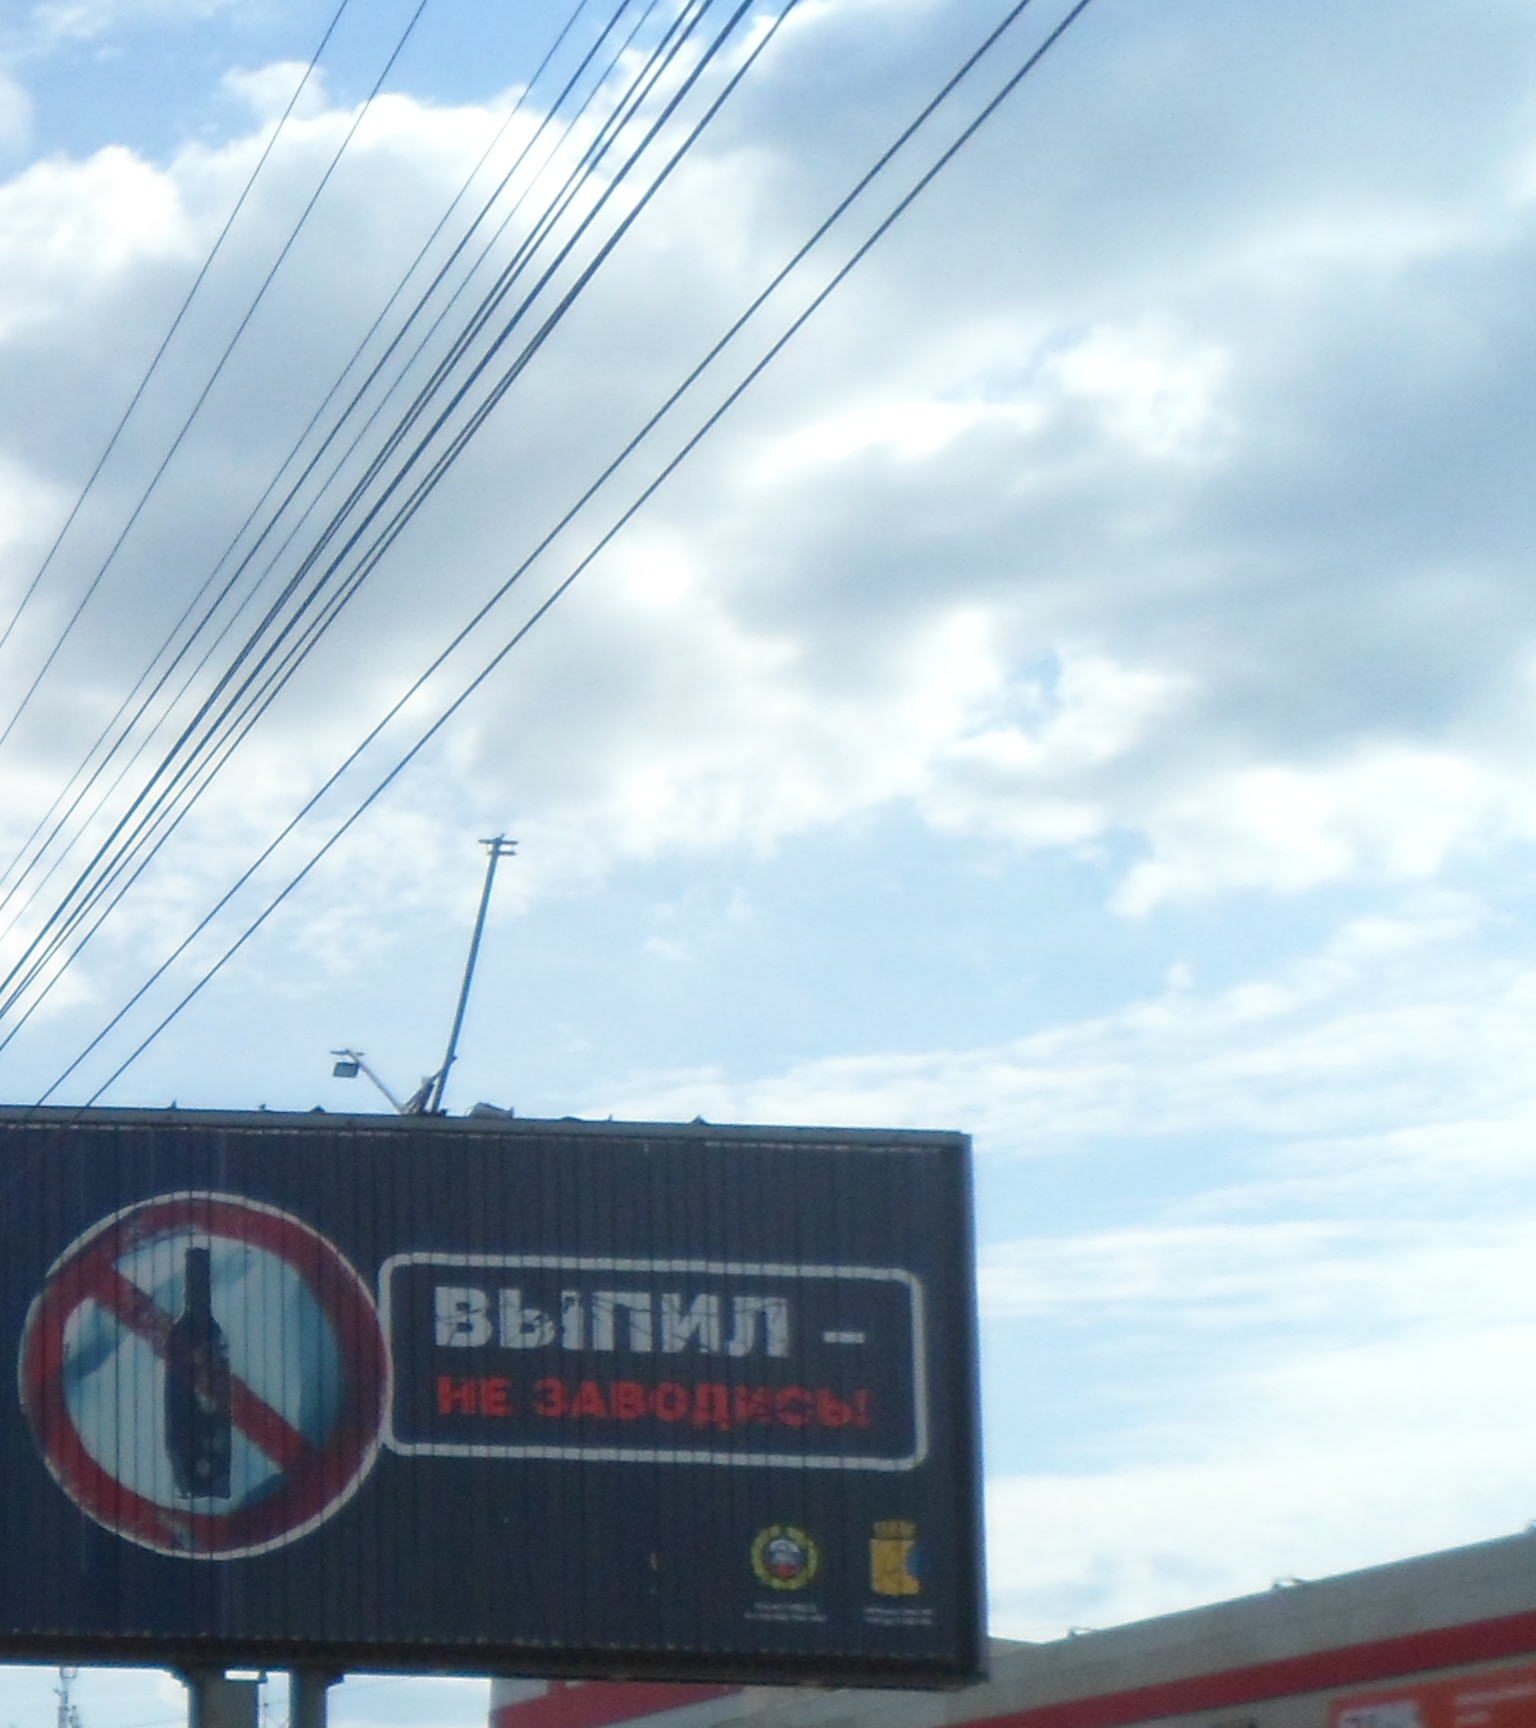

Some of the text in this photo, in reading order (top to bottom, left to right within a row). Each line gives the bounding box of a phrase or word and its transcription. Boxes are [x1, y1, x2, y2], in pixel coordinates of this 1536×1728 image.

[434, 1286, 790, 1357] ВЫПИЛ
[436, 1375, 872, 1430] НЕ ЗАВОДИСЬ!
